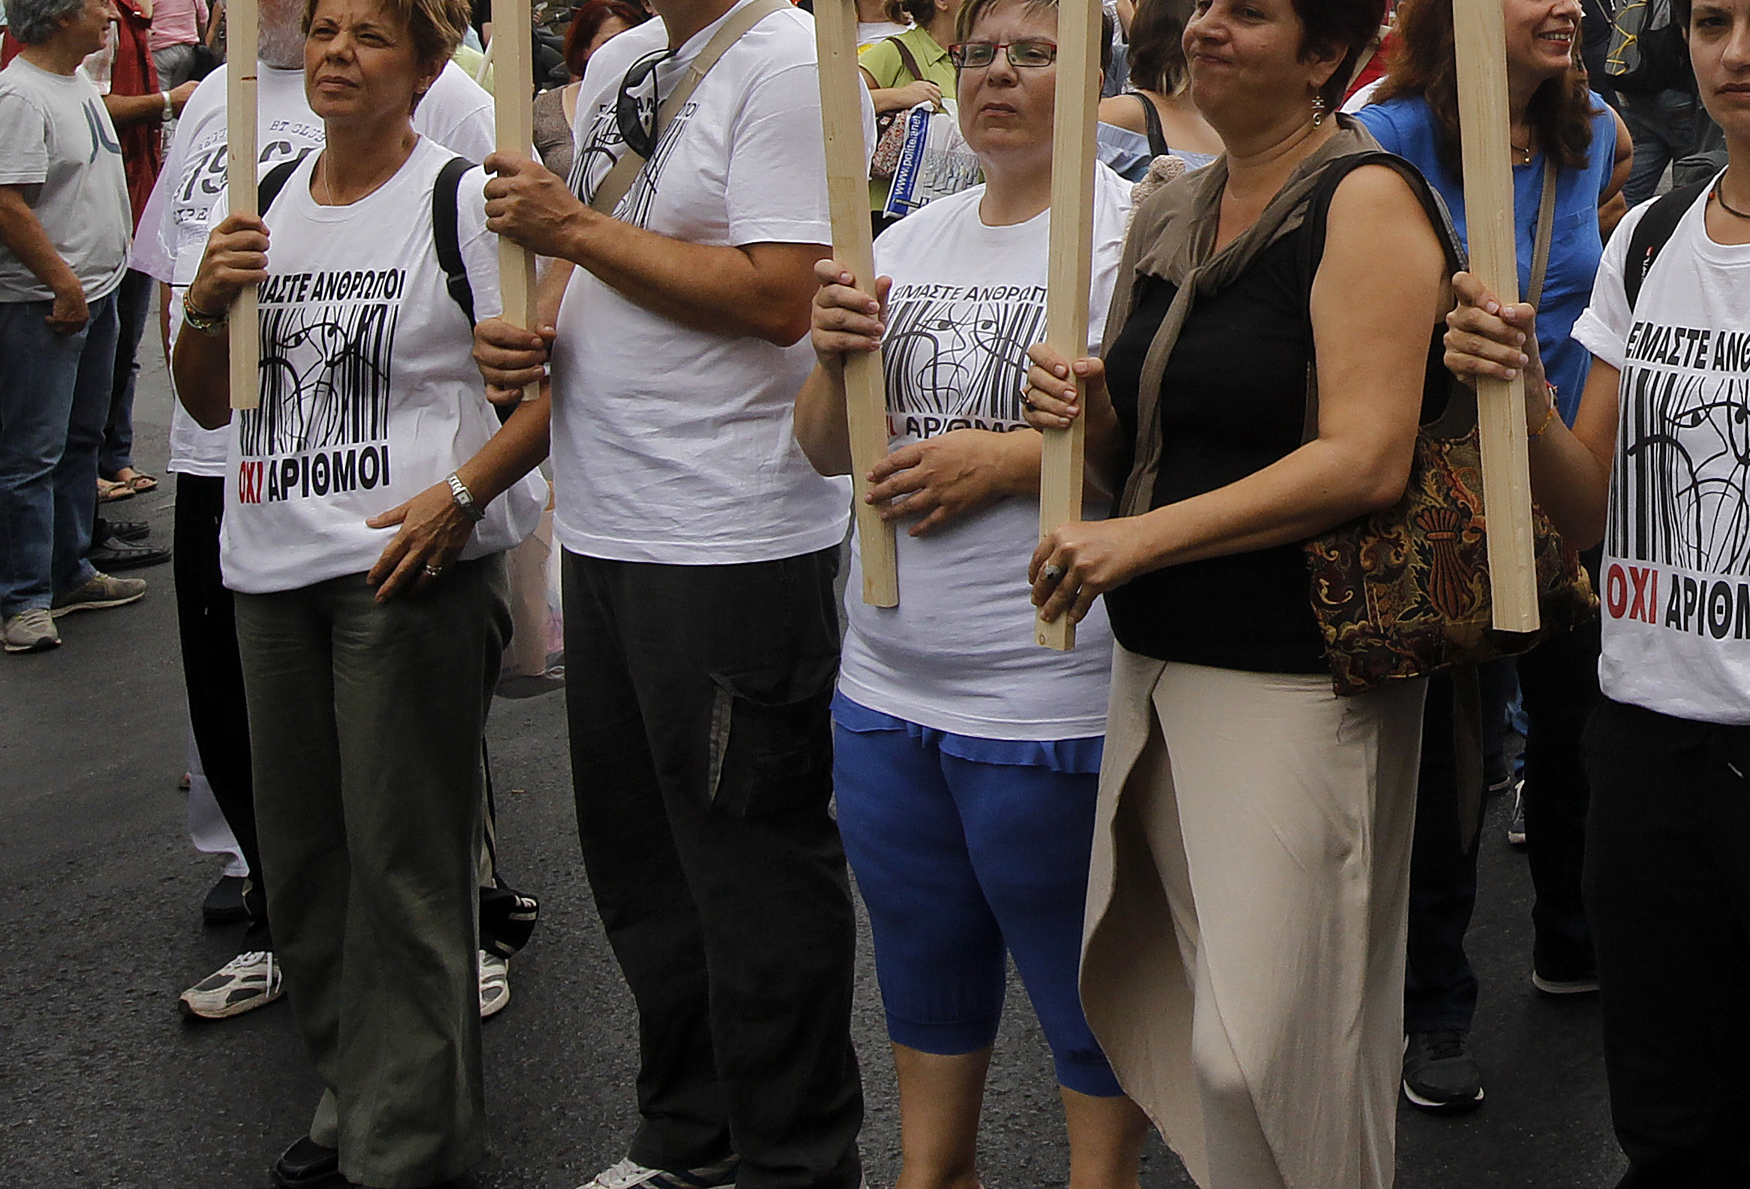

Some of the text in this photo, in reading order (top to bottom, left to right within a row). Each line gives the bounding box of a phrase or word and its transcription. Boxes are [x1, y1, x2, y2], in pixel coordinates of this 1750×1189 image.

[310, 268, 406, 301] ΑΝΘΡΩΠΟΙ
[890, 284, 1047, 302] ΕΙΜΑΣΤΕ ΑΝΘΡΩΠ
[1625, 322, 1711, 370] ΕΙΜΑΣΤΕ
[238, 445, 390, 504] ΟΧΙ ΑΡΙΘΜΟΙ
[1606, 563, 1658, 624] ΟΧΙ
